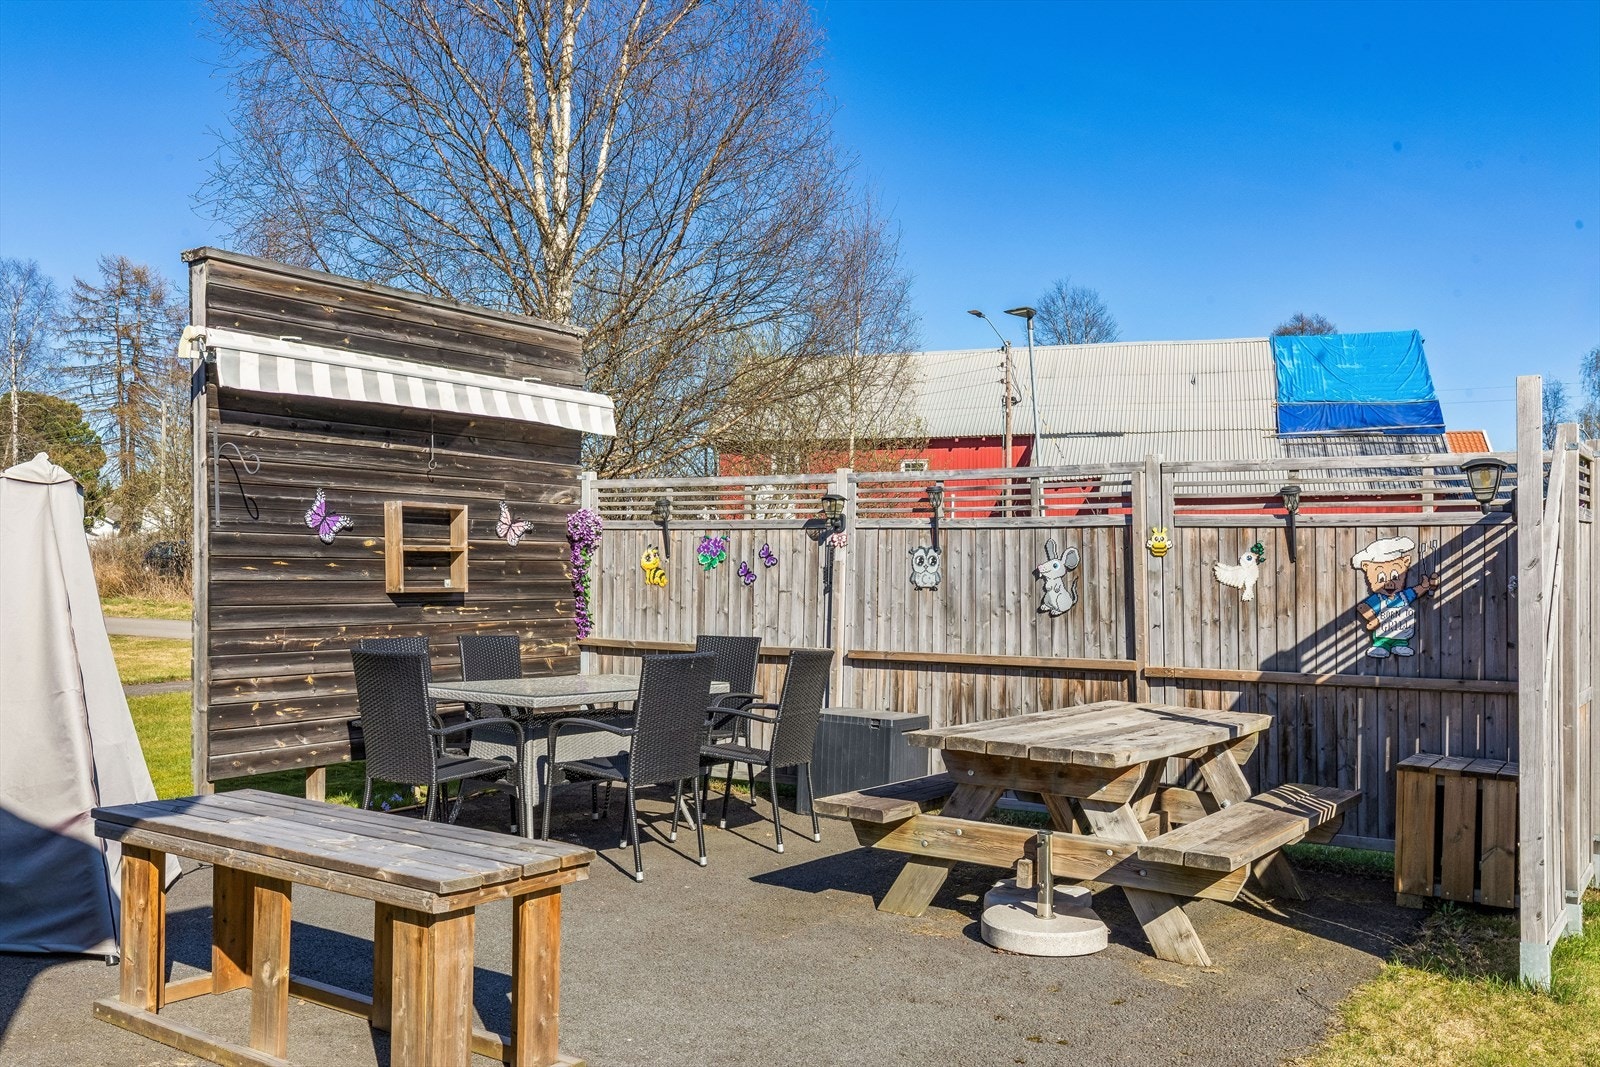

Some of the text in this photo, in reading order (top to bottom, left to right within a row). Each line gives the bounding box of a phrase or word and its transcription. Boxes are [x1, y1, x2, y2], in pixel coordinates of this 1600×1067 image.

[1380, 609, 1414, 620] BORN TO
[1381, 620, 1411, 632] GRILL
